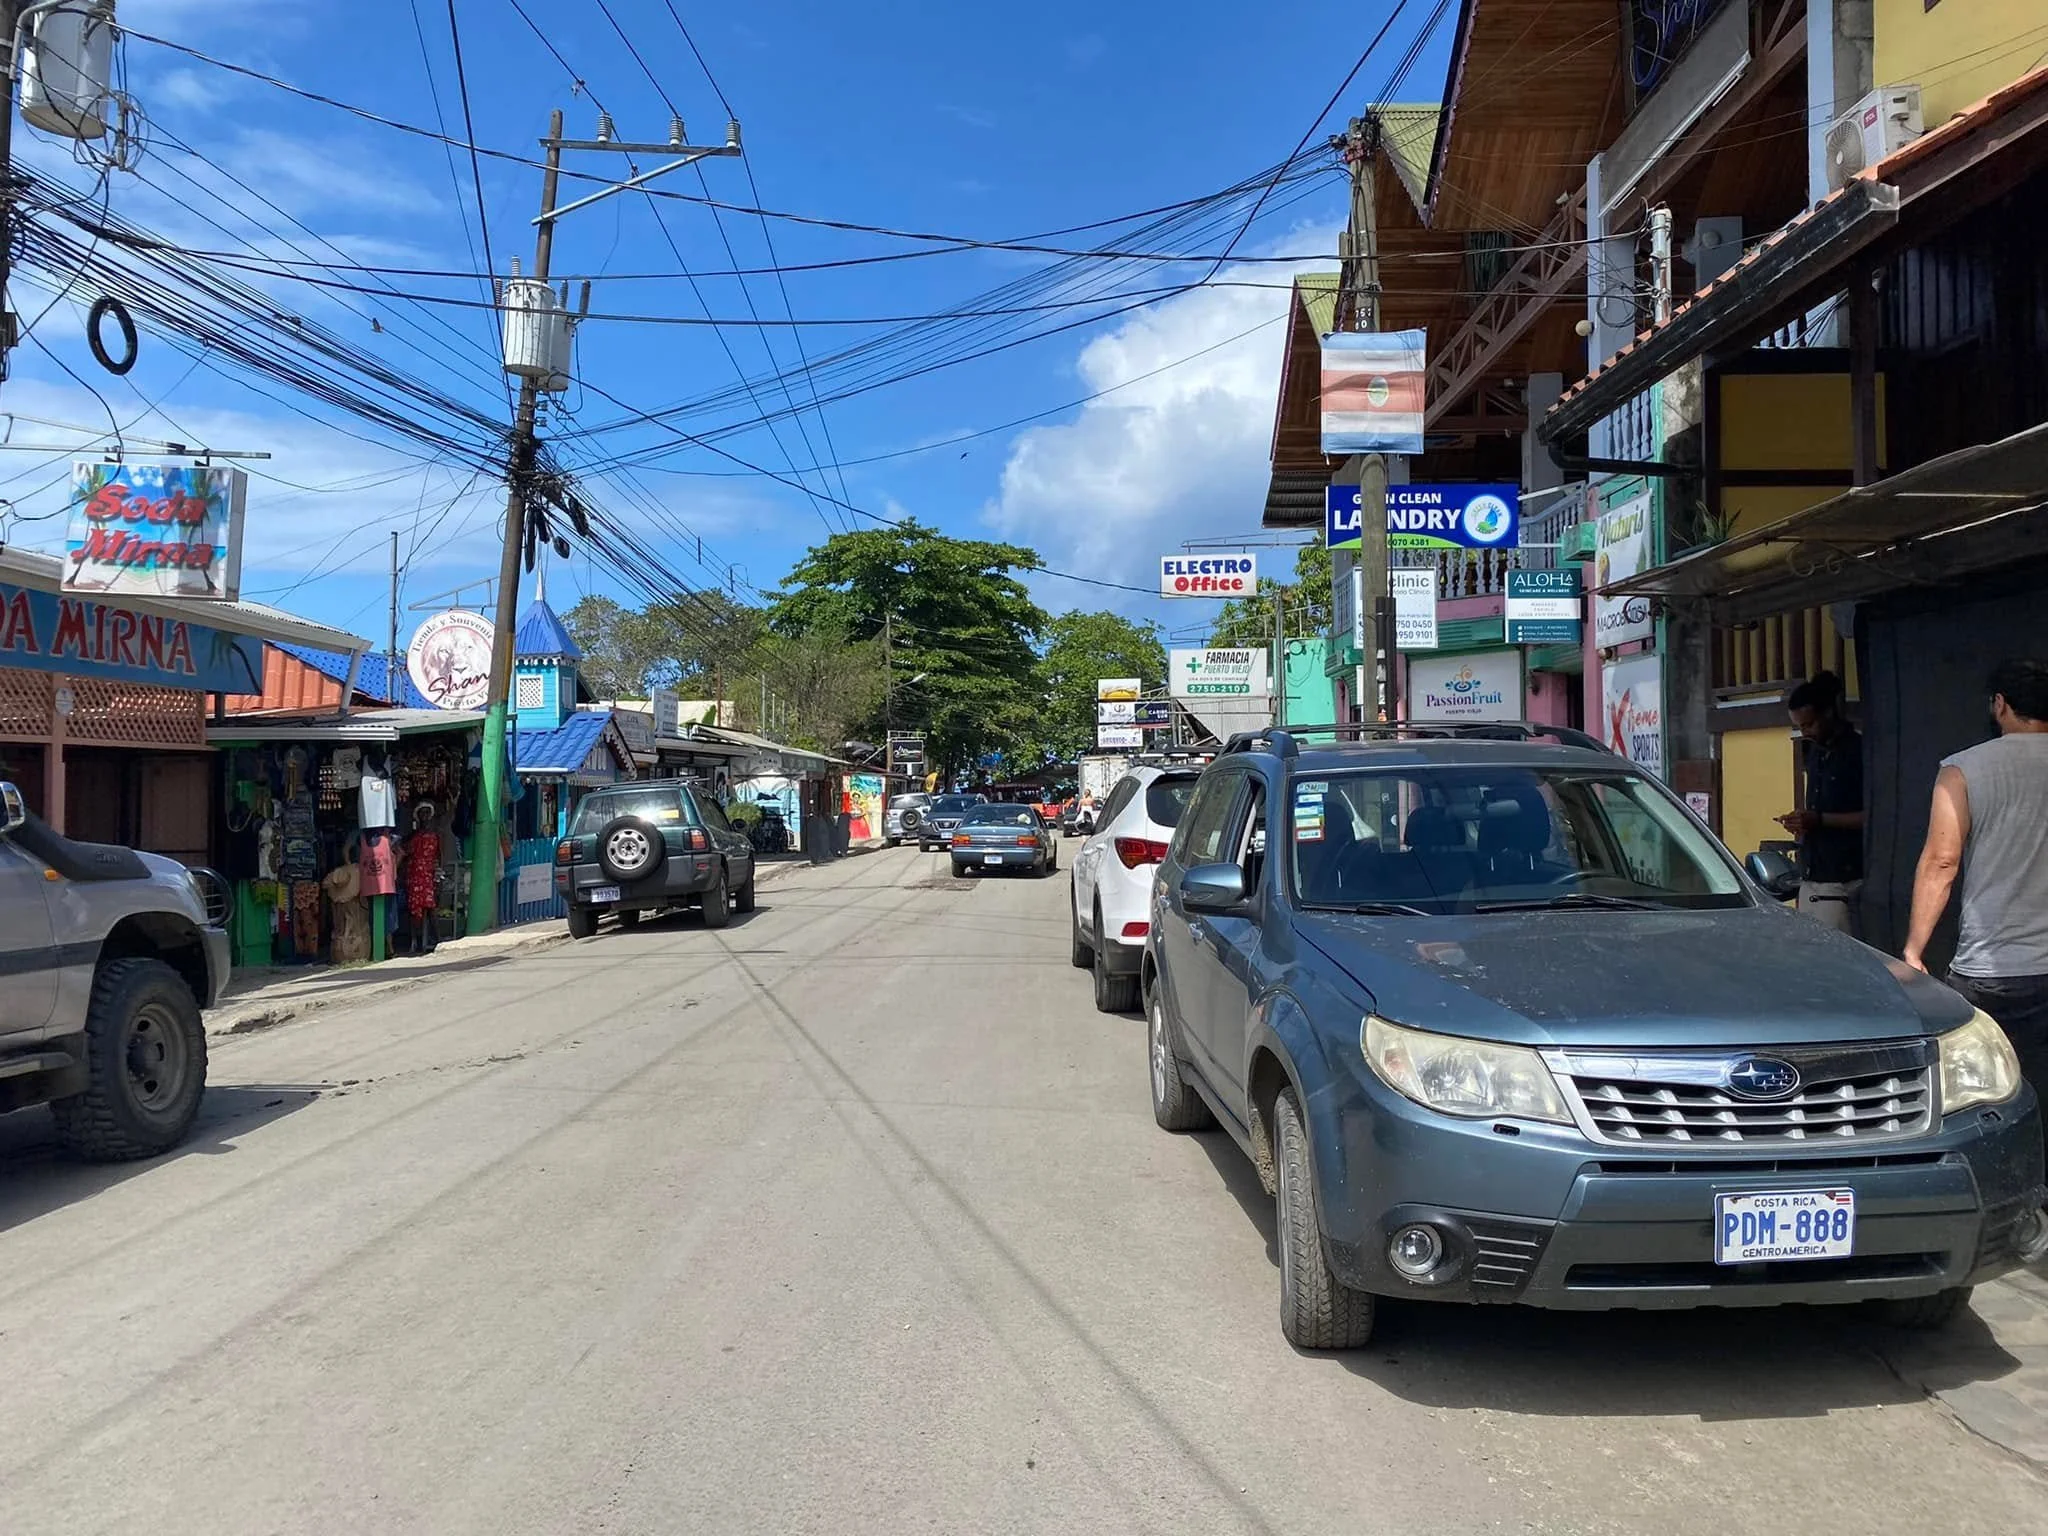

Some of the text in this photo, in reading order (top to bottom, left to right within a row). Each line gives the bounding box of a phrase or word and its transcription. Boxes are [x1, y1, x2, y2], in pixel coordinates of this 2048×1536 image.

[84, 484, 207, 524] Soda
[1399, 493, 1441, 504] CLEAN
[1334, 509, 1461, 530] LANDRY
[71, 528, 214, 568] Mirna
[1410, 538, 1429, 546] 4381
[1164, 559, 1251, 575] ELECTRO
[1175, 576, 1243, 591] Office
[1514, 573, 1574, 586] ALOHA
[0, 590, 196, 675] A MIRNA
[1205, 652, 1249, 664] FARMACIA
[1204, 664, 1250, 673] PUERTO VIEJO
[1426, 691, 1502, 707] PassionFruit
[1632, 733, 1660, 762] SPORTS
[1754, 1197, 1817, 1208] COSTA RICA
[1724, 1208, 1848, 1247] PDM-888
[1742, 1246, 1827, 1258] CENTROAMERICA
